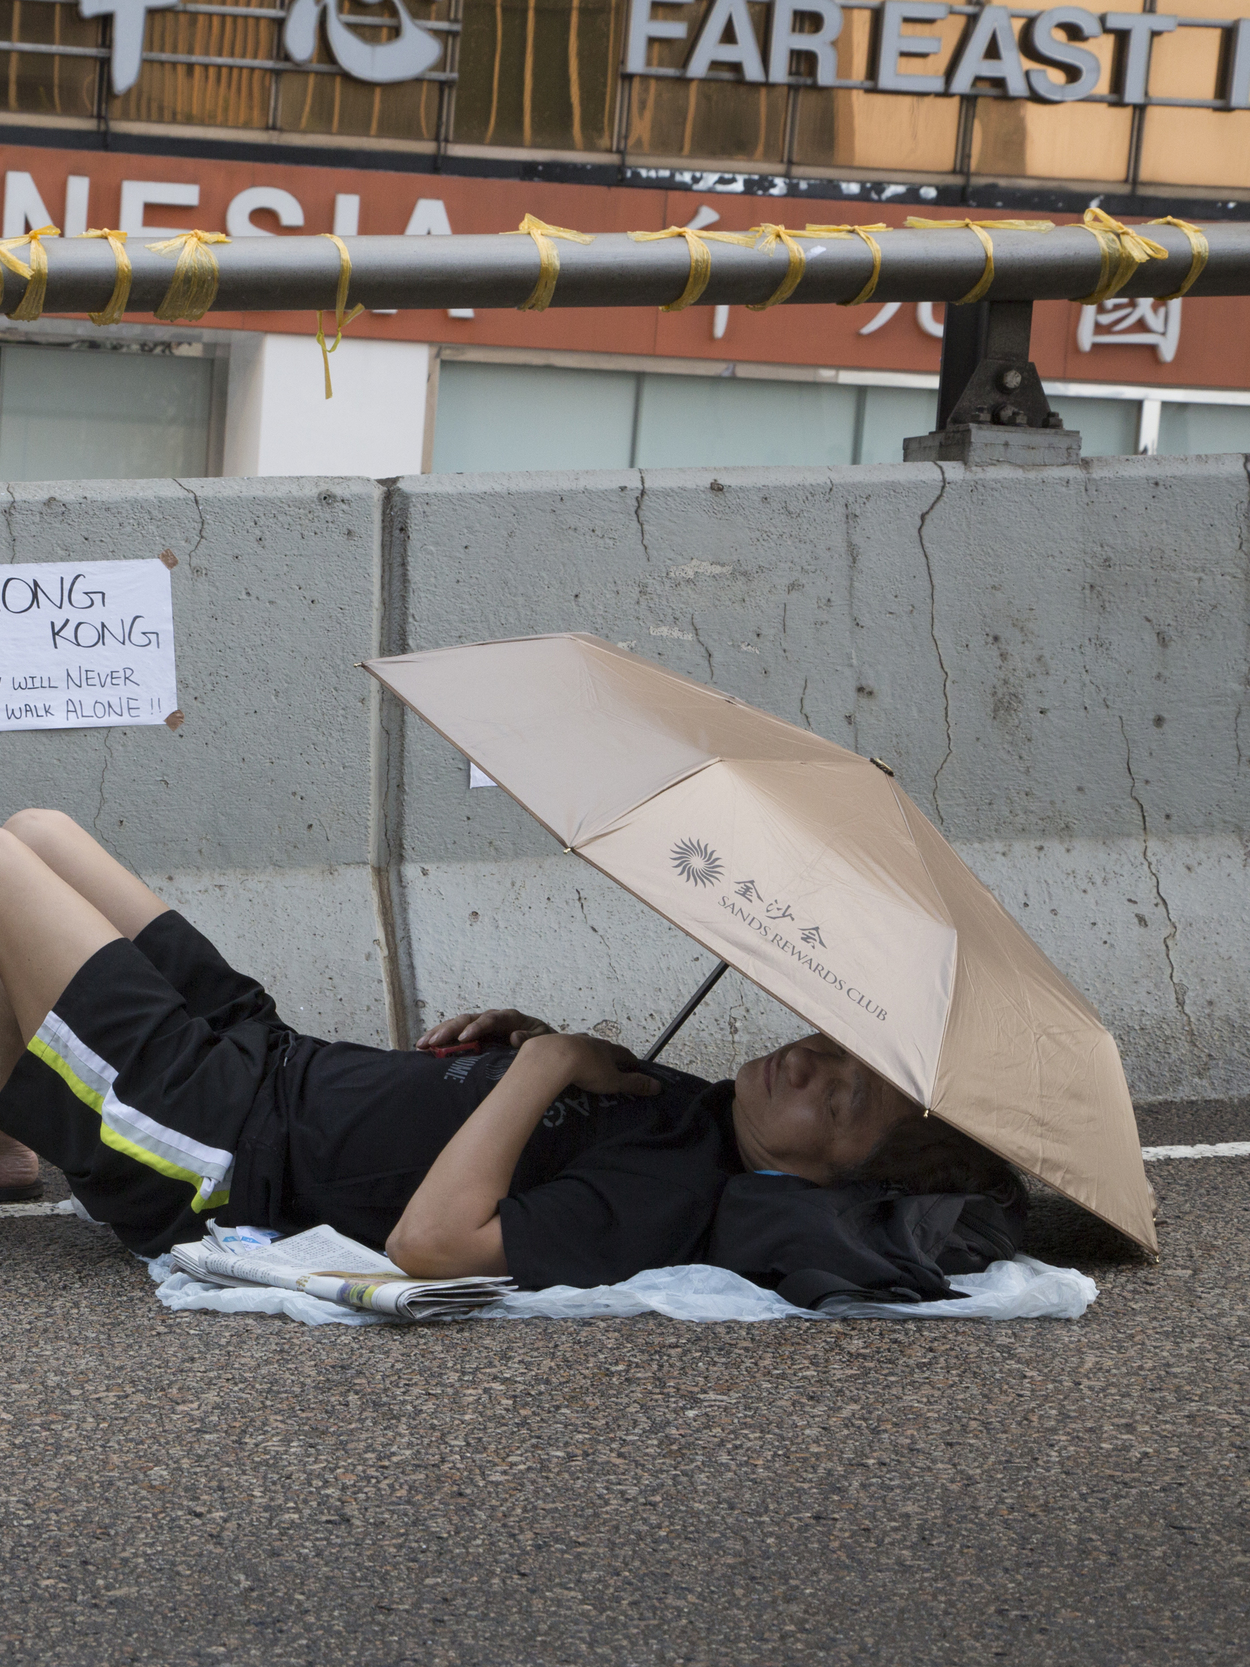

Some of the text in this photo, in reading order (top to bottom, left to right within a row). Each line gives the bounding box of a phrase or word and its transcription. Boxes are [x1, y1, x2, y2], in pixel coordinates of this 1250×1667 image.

[627, 0, 845, 87] FAR
[877, 0, 1178, 104] EAST
[50, 615, 160, 649] KONG
[12, 675, 59, 691] WILL
[66, 665, 140, 690] NEVER
[5, 703, 55, 721] WALK
[66, 696, 141, 721] ALONE
[733, 879, 828, 950] 金沙会
[717, 895, 889, 1022] SANDS REWARDS CLUB
